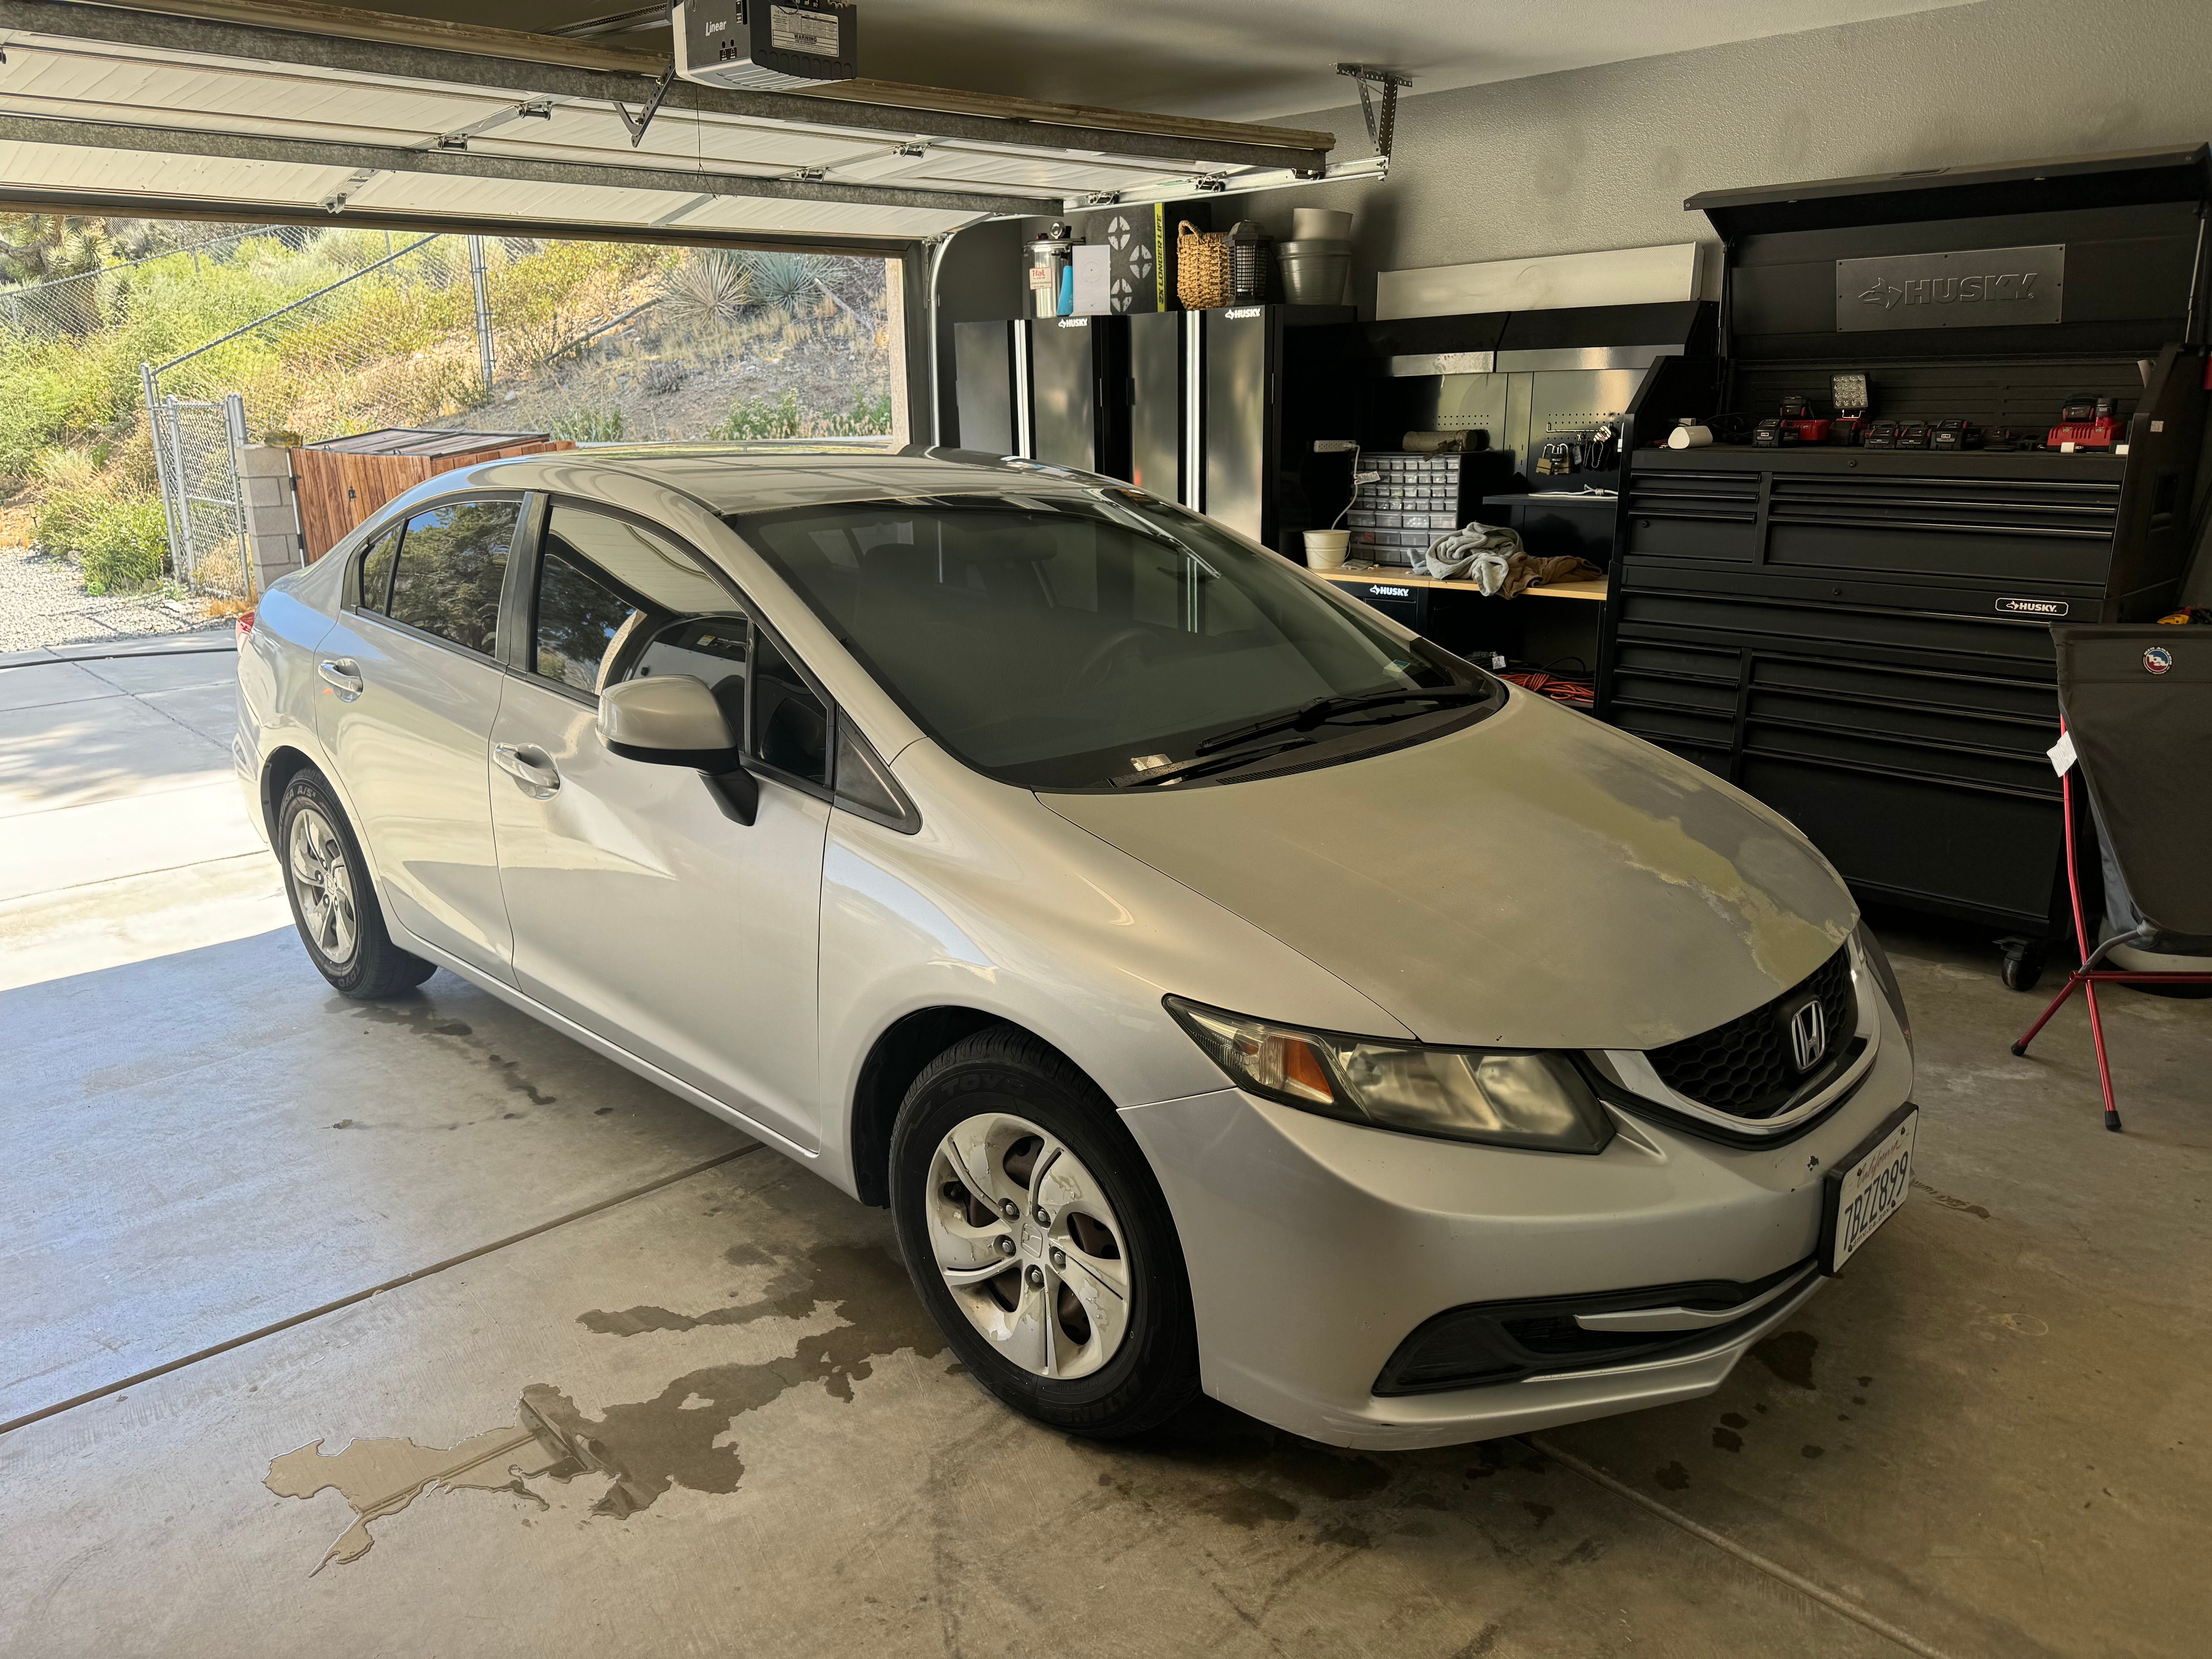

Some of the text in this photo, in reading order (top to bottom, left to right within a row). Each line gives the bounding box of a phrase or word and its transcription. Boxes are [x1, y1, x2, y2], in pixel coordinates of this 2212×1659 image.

[706, 21, 726, 36] Linear
[794, 34, 817, 42] WARNING
[1905, 273, 2037, 304] HUSKY
[1159, 290, 1164, 304] 2X
[1234, 308, 1261, 318] HUSKY
[1066, 318, 1088, 327] HUSKY
[1380, 586, 1409, 596] HUSKY
[2019, 603, 2057, 612] HUSKY
[941, 1074, 1027, 1096] TOYO
[1857, 1139, 1902, 1188] California
[1844, 1151, 1908, 1251] 7BZZ899
[1852, 1206, 1890, 1247] dmv.ca.gov
